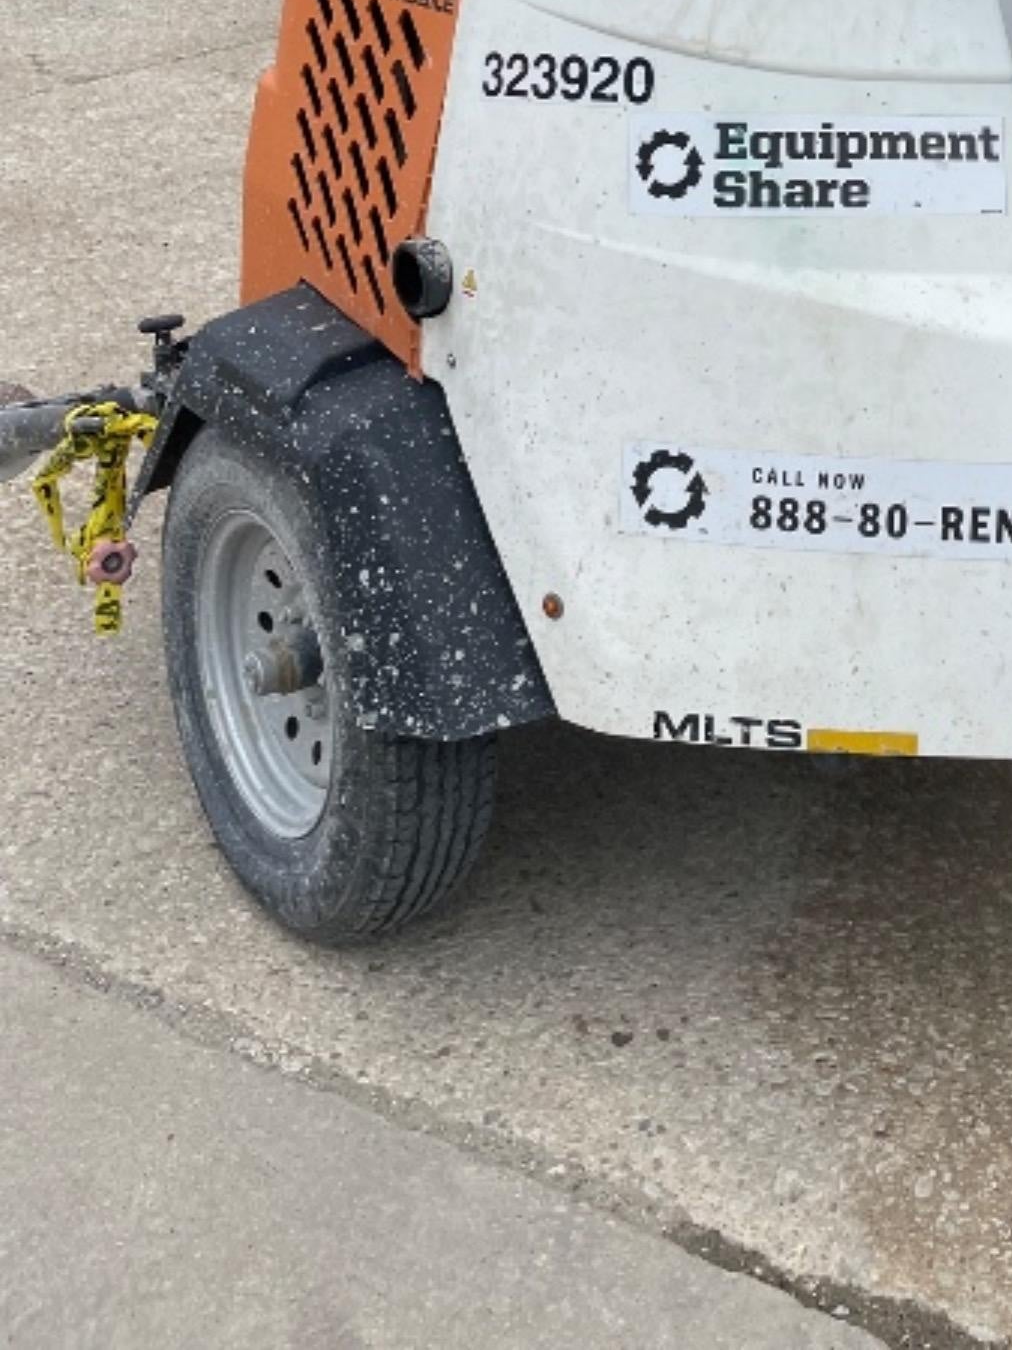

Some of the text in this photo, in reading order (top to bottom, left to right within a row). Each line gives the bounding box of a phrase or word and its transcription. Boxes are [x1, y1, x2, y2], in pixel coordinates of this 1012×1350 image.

[482, 50, 655, 105] 323920
[714, 121, 1000, 167] Equipment
[713, 170, 870, 209] Share
[751, 467, 866, 491] CALL NOW
[652, 710, 802, 748] MLTS
